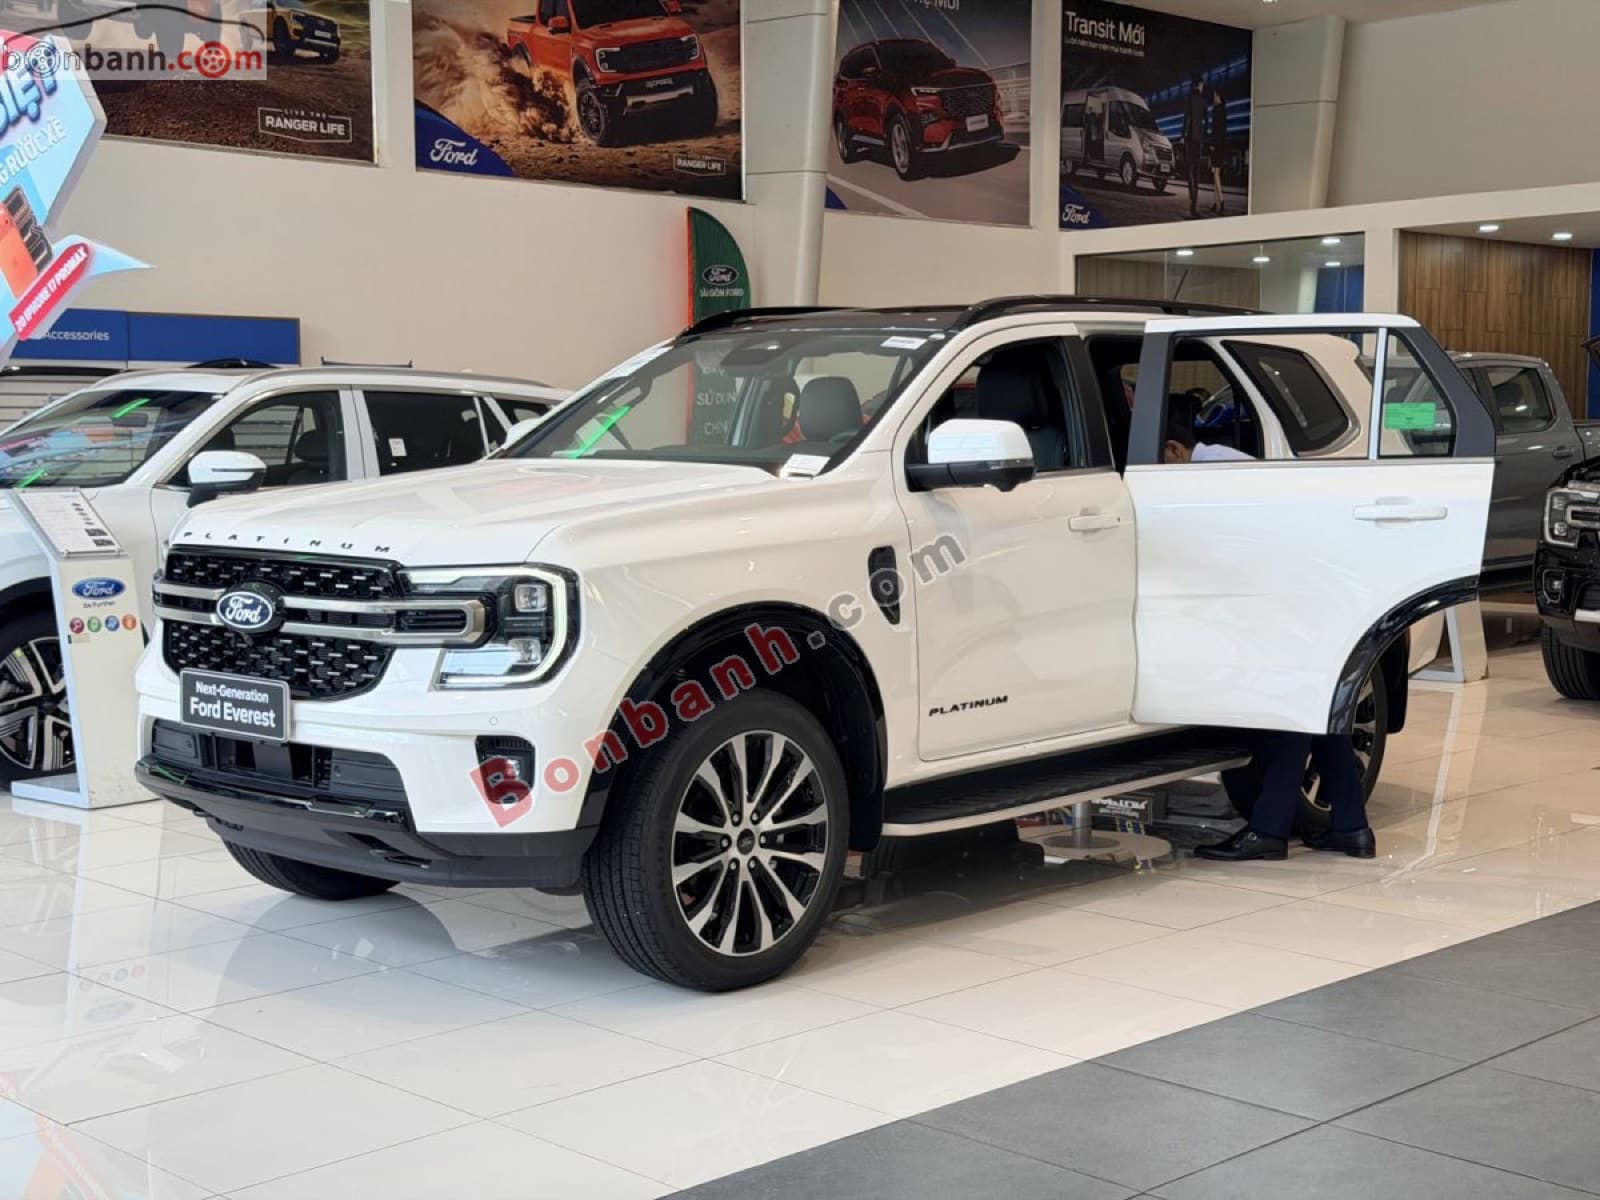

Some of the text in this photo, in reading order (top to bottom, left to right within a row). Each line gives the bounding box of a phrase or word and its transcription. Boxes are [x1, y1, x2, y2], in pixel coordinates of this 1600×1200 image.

[1064, 11, 1145, 46] Transit Mới
[265, 115, 345, 136] RANGER LIFE
[430, 139, 477, 166] Ford
[1062, 203, 1090, 225] Ford
[708, 267, 733, 282] Ford
[183, 531, 391, 553] PLATINUM
[224, 596, 262, 624] Ford
[195, 680, 269, 704] Next-Generation
[190, 696, 277, 729] Ford Everest
[928, 694, 1009, 718] PLATINUM
